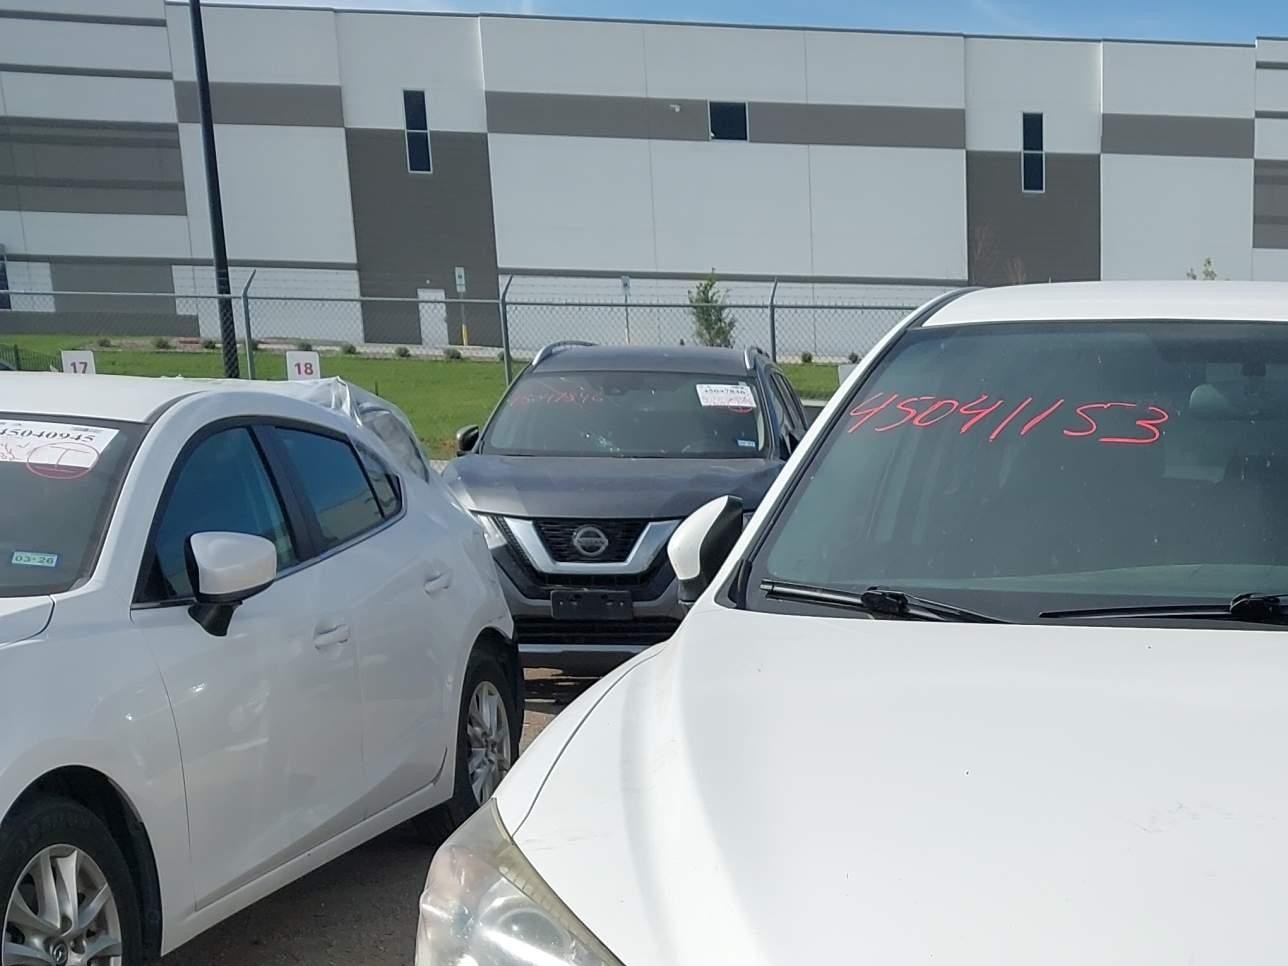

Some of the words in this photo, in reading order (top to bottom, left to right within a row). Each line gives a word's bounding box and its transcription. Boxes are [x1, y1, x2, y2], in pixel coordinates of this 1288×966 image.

[70, 361, 88, 374] 17
[294, 362, 314, 376] 18
[847, 392, 1169, 443] 45041153
